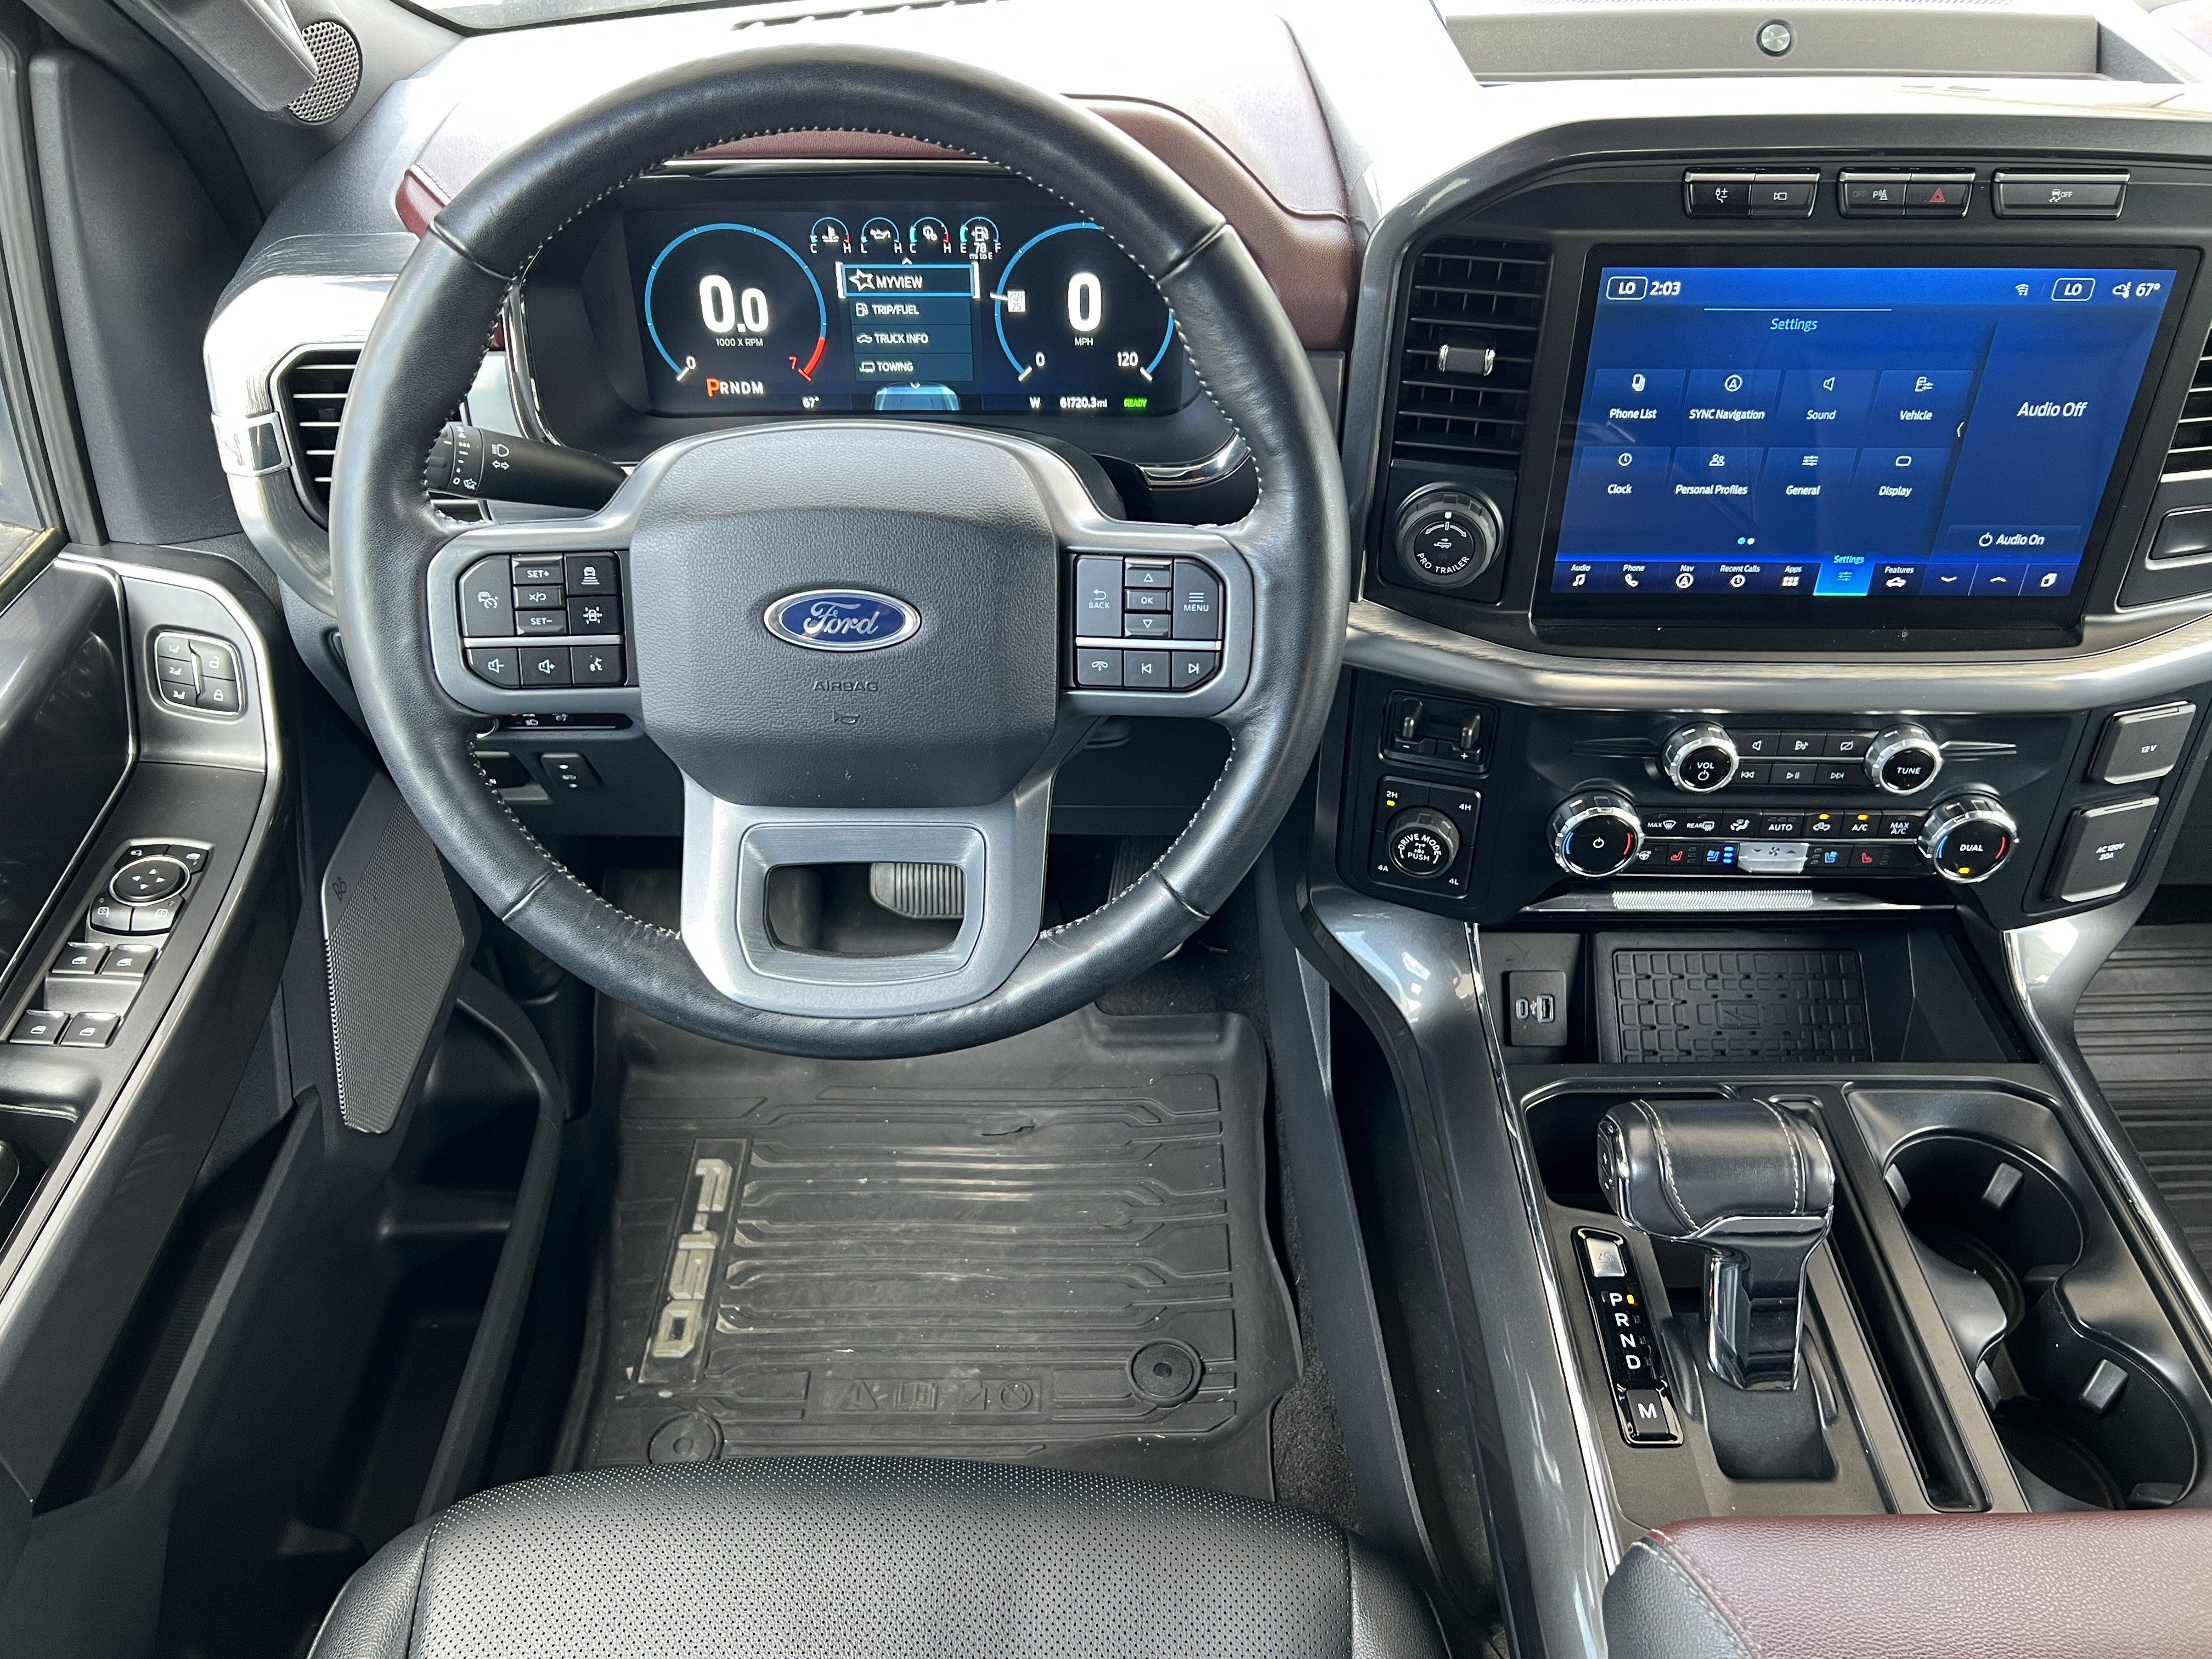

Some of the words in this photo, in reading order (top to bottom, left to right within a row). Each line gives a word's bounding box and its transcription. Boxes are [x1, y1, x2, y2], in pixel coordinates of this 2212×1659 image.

[810, 243, 817, 253] C
[843, 243, 851, 253] H
[861, 243, 867, 253] L
[894, 243, 902, 253] H
[910, 243, 916, 253] C
[943, 243, 951, 253] H
[960, 243, 967, 253] E
[973, 242, 987, 253] 78
[995, 243, 1001, 253] F
[876, 275, 923, 289] MYVIEW
[1618, 281, 1637, 295] LO
[1649, 281, 1681, 296] 2:03
[2063, 283, 2083, 296] LO
[2135, 282, 2162, 297] 67°
[698, 274, 769, 333] 0.0
[1012, 302, 1021, 311] 25
[1068, 272, 1102, 331] 0
[872, 305, 919, 316] TRIP/FUEL
[1770, 318, 1818, 331] Settings
[716, 338, 735, 347] 1000
[737, 338, 744, 347] X
[745, 338, 763, 347] RPM
[874, 333, 905, 344] TRUCK
[906, 333, 929, 344] INFO
[1074, 337, 1093, 347] MPH
[685, 356, 696, 370] 0
[789, 356, 798, 369] 7
[1035, 352, 1045, 367] 0
[1117, 352, 1138, 367] 120
[876, 361, 914, 373] TOWING
[1029, 397, 1041, 408] W
[1124, 397, 1148, 408] READY
[1609, 408, 1640, 419] Phone
[1640, 408, 1657, 419] List
[1689, 409, 1715, 420] SYNC
[1715, 409, 1765, 421] Navigation
[1806, 409, 1836, 420] Sound
[1899, 409, 1933, 421] Vehicle
[2017, 402, 2060, 417] Audio
[2062, 402, 2088, 417] Off
[1607, 484, 1632, 494] Clock
[1675, 484, 1714, 495] Personal
[1714, 484, 1748, 495] Profiles
[1785, 485, 1821, 495] General
[1878, 486, 1912, 498] Display
[1995, 533, 2028, 545] Audio
[2028, 534, 2045, 545] On
[1417, 552, 1432, 569] PRO
[1435, 556, 1470, 574] TRAILER
[1833, 555, 1865, 565] Settings
[1570, 563, 1592, 572] Audio
[1623, 564, 1645, 572] Phone
[1784, 565, 1802, 574] Apps
[1884, 566, 1915, 574] Features
[1141, 596, 1153, 605] OK
[803, 601, 881, 635] Ford
[813, 680, 878, 692] AIRBAG
[1386, 791, 1398, 799] 2H
[1459, 803, 1471, 811] 4H
[1397, 833, 1420, 850] DRIVE
[1421, 834, 1442, 856] MODE
[1959, 844, 1983, 852] DUAL
[2096, 845, 2108, 854] AC
[1407, 851, 1430, 861] PUSH
[2099, 852, 2114, 861] 20A
[1378, 864, 1389, 872] 4A
[652, 1157, 733, 1358] F-150
[1609, 1293, 1623, 1306] P
[1614, 1313, 1629, 1327] R
[1620, 1334, 1636, 1348] N
[1626, 1355, 1641, 1369] D
[1637, 1403, 1657, 1419] M
